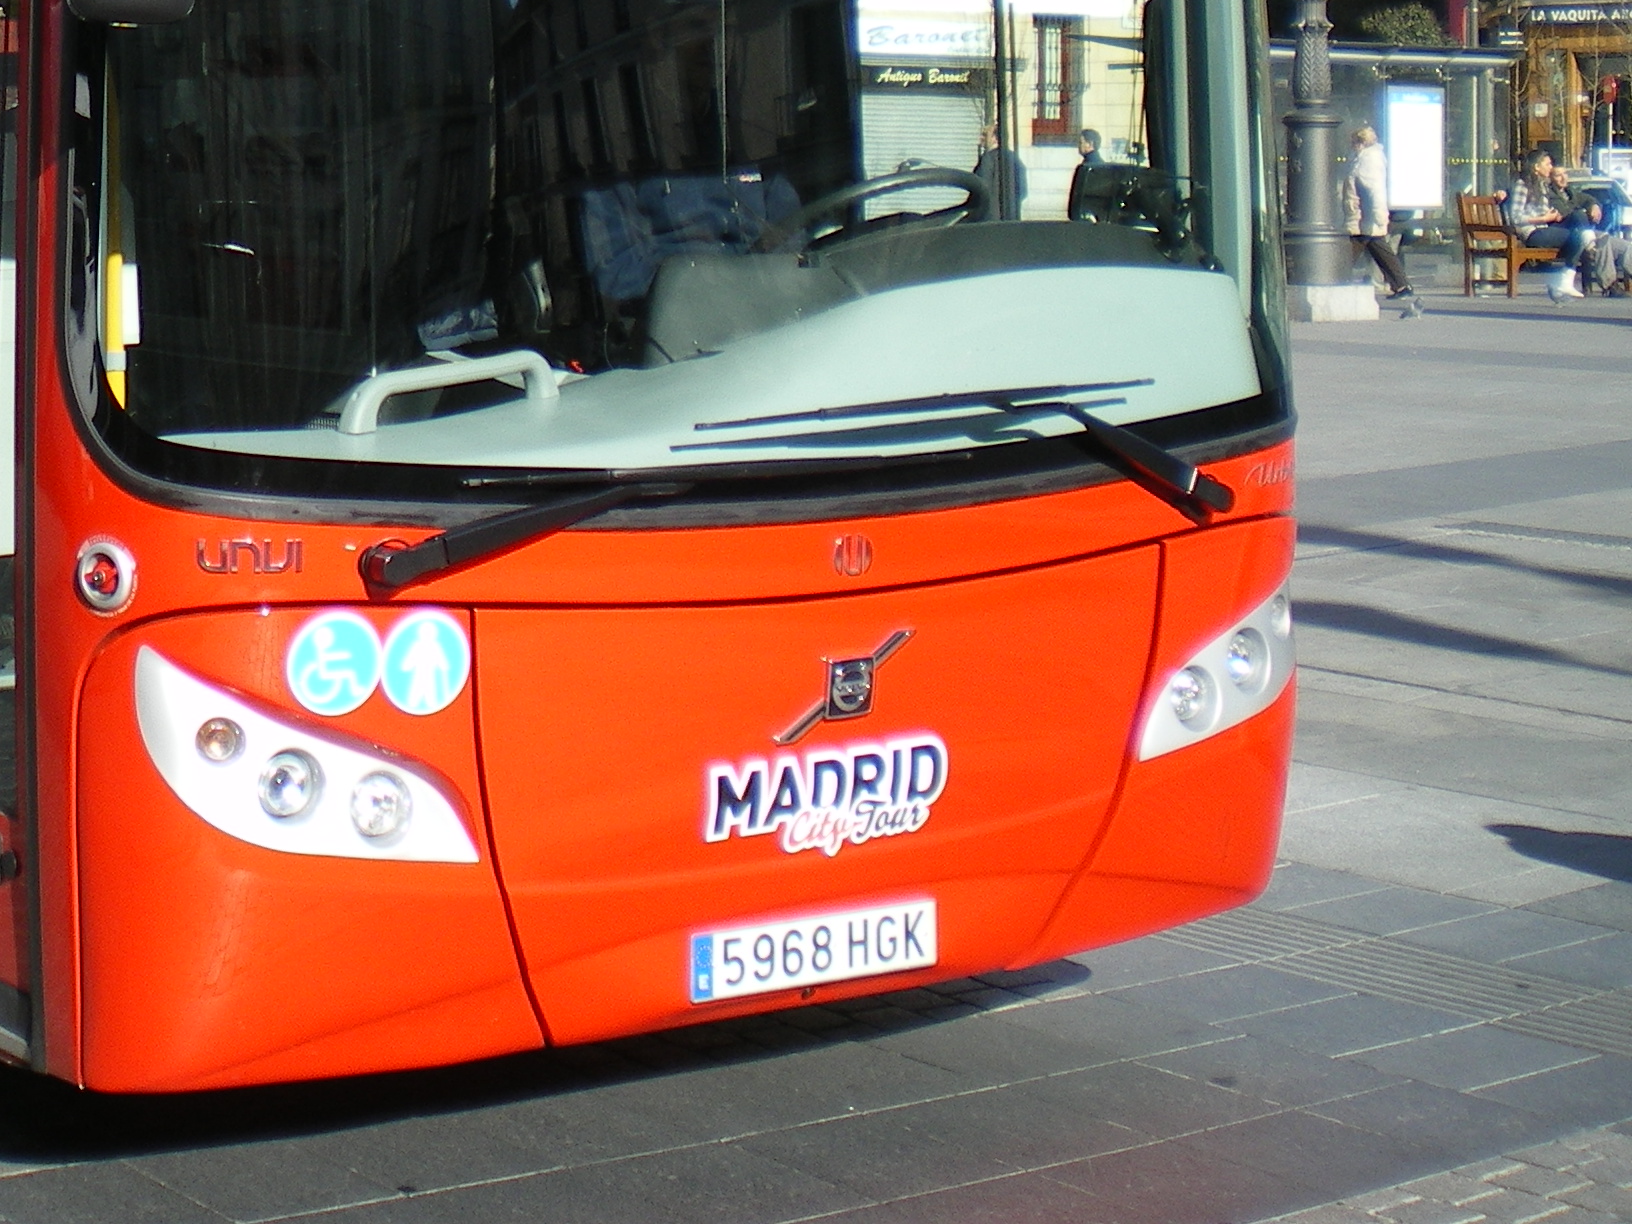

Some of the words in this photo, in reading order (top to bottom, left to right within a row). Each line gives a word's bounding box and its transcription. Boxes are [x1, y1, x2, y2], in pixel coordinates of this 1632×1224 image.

[1531, 9, 1547, 22] LA
[1551, 9, 1607, 23] VAQUITA
[706, 738, 948, 844] MADRID
[785, 810, 856, 856] City
[854, 798, 929, 844] Tour
[722, 925, 832, 986] 5968
[848, 910, 925, 969] HGK
